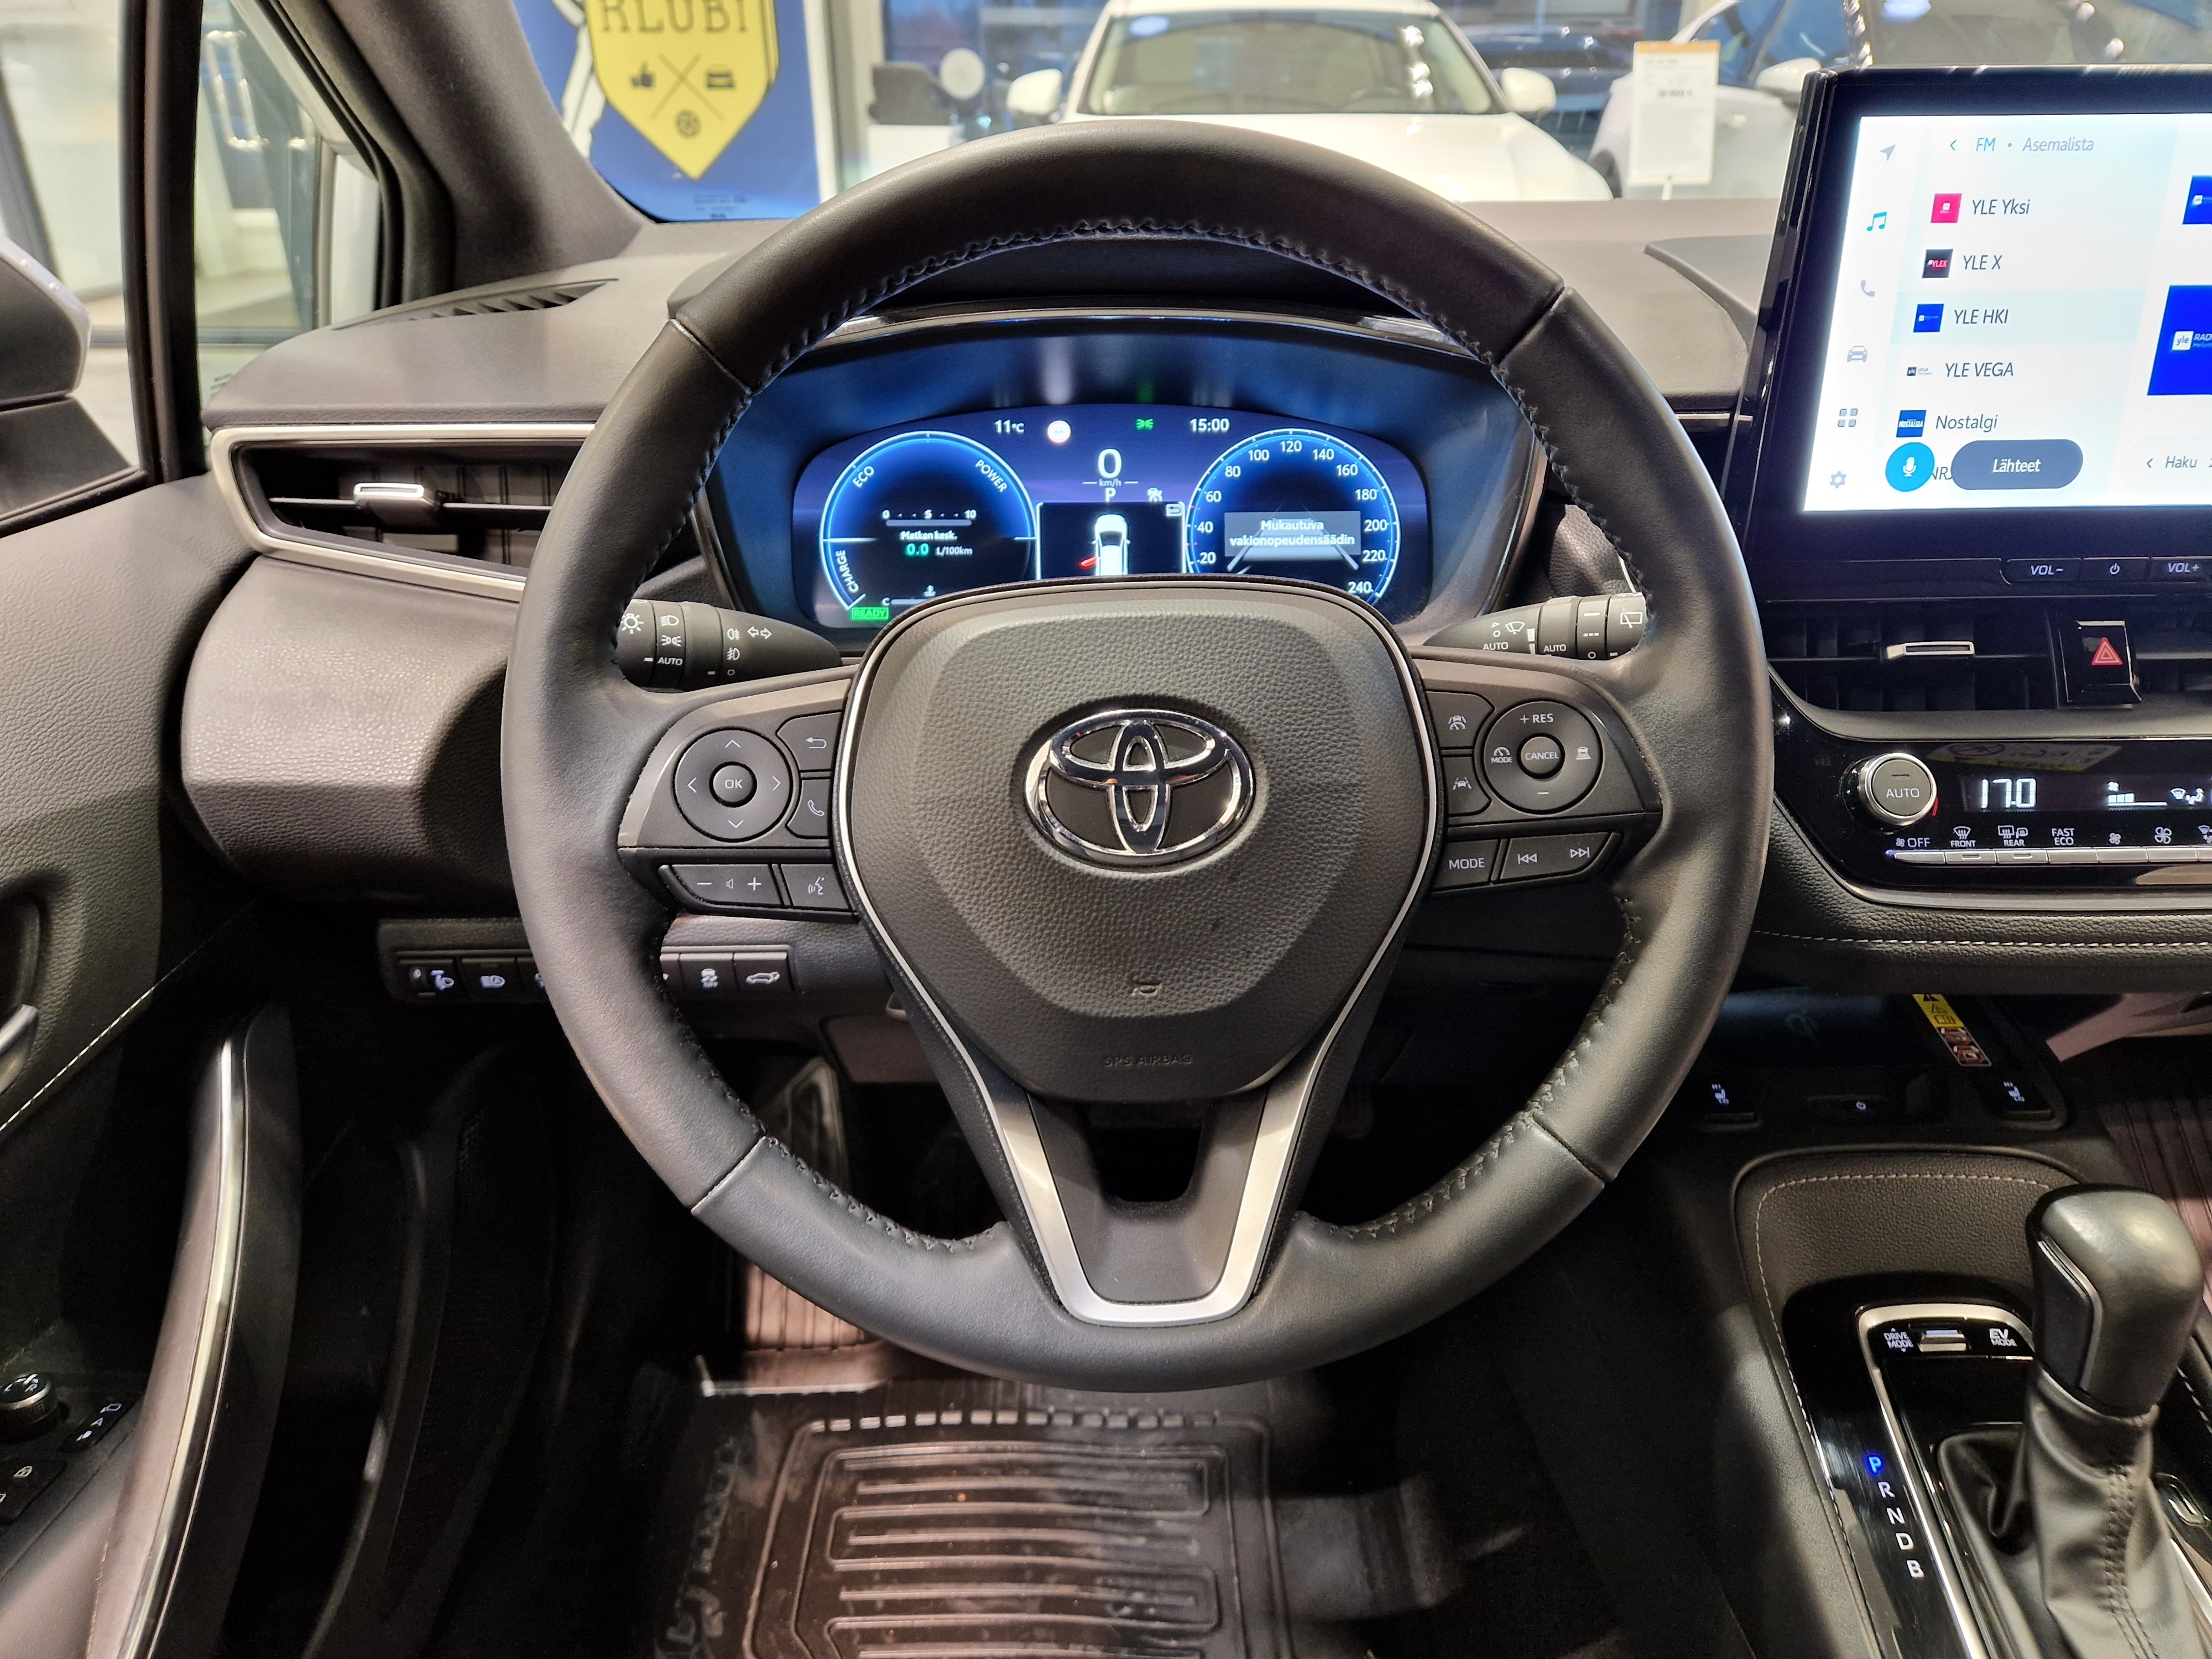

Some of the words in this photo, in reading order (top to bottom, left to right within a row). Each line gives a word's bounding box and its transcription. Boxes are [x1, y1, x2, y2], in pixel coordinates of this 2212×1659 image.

[1976, 138, 1996, 152] FM
[2022, 137, 2094, 152] Asemalista
[1971, 200, 1997, 215] YLE
[2002, 200, 2030, 215] Yksi
[1963, 255, 1989, 270] YLE
[1991, 255, 2002, 270] X
[1954, 310, 1979, 325] YLE
[1982, 309, 2008, 324] HKI
[2176, 335, 2189, 346] yle
[1945, 363, 1970, 378] YLE
[1974, 362, 2014, 377] VEGA
[1190, 418, 1230, 432] 15:00
[1936, 415, 1998, 431] Nostalgi
[1280, 440, 1302, 453] 120
[1249, 449, 1270, 461] 100
[1312, 448, 1334, 461] 140
[1098, 448, 1122, 478] 0
[1992, 458, 2041, 473] Lähteet
[2165, 456, 2198, 468] Haku
[1225, 466, 1241, 478] 80
[1336, 463, 1358, 476] 160
[852, 466, 875, 488] ECO
[975, 459, 1008, 493] POWER
[1105, 487, 1116, 502] P
[1206, 491, 1222, 502] 60
[1355, 488, 1377, 500] 180
[882, 510, 890, 520] 0
[924, 509, 932, 519] 5
[964, 509, 977, 519] 10
[1197, 521, 1213, 533] 40
[1261, 519, 1324, 531] Mukautuva
[1364, 519, 1387, 531] 200
[900, 530, 933, 540] Matkan
[934, 530, 958, 540] kesk.
[1230, 534, 1355, 548] vakionopeudensäädin
[906, 543, 930, 556] 0.0
[935, 546, 973, 556] L/100km
[1199, 552, 1216, 564] 20
[1363, 550, 1385, 562] 220
[836, 549, 859, 593] CHARGE
[1348, 581, 1372, 594] 240
[881, 597, 890, 606] C
[854, 609, 886, 618] READY
[1483, 641, 1509, 650] AUTO
[1543, 644, 1566, 653] AUTO
[658, 657, 682, 665] AUTO
[1532, 713, 1554, 723] RES
[725, 779, 743, 789] OK
[1886, 788, 1919, 799] AUTO
[1981, 778, 2036, 808] 17.0
[2052, 828, 2074, 837] FAST
[1908, 838, 1930, 847] OFF
[2054, 837, 2074, 846] ECO
[1449, 858, 1485, 869] MODE
[1104, 1057, 1131, 1067] SRS
[1137, 1055, 1192, 1066] AIRBAG
[1884, 1332, 1910, 1340] DRIVE
[1990, 1328, 2008, 1339] EV
[1887, 1339, 1914, 1348] MODE
[1991, 1338, 2018, 1347] MODE
[1868, 1456, 1882, 1473] P
[1878, 1481, 1895, 1498] R
[1886, 1507, 1906, 1525] N
[1895, 1532, 1914, 1551] D
[1906, 1559, 1924, 1578] B
